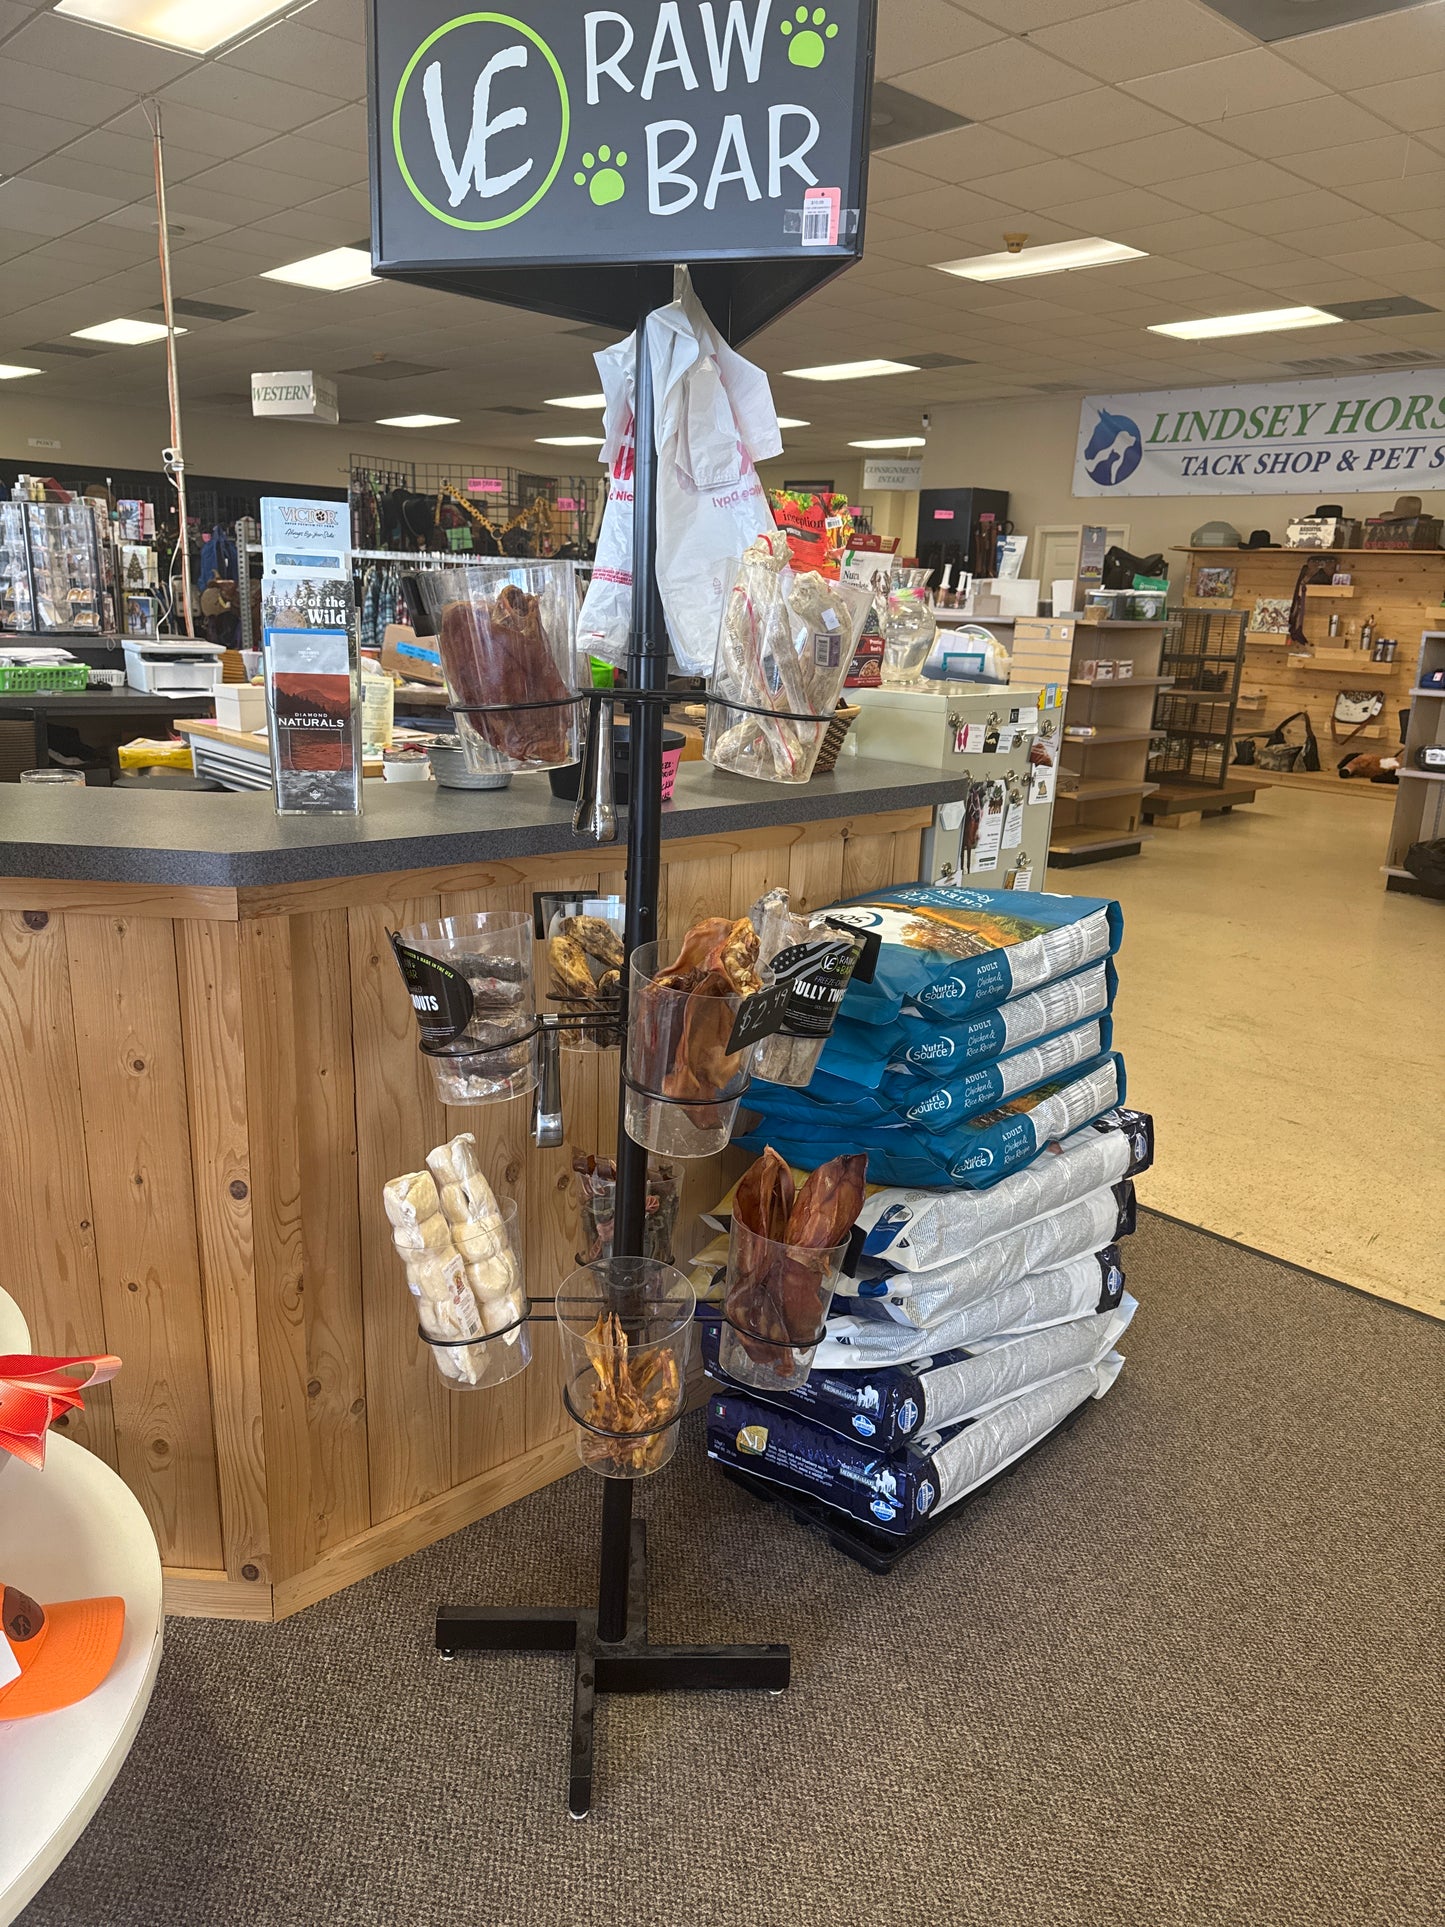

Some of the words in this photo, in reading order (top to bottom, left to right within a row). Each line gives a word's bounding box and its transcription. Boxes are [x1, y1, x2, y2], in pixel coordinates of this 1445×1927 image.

[584, 0, 772, 105] RAW
[645, 104, 820, 216] BAR
[252, 385, 312, 402] WESTERN
[1145, 402, 1327, 444] LINDSEY
[1181, 455, 1252, 477] TACK
[1253, 450, 1332, 475] SHOP
[1336, 449, 1361, 472] &
[1363, 446, 1427, 471] PET
[865, 466, 920, 474] CONSIGNMENT
[878, 475, 905, 483] INTAKE
[279, 506, 338, 526] VICTOR
[783, 510, 825, 529] inception
[271, 595, 304, 607] Taste
[308, 595, 321, 607] of
[325, 595, 346, 608] the
[308, 608, 347, 625] Wild
[278, 717, 345, 728] NATURALS
[976, 961, 999, 975] ADULT
[932, 981, 955, 994] Nutri
[924, 989, 958, 1002] Source
[968, 1019, 992, 1034] ADULT
[921, 1041, 944, 1053] Nutri
[967, 1032, 990, 1047] Chicken
[913, 1048, 948, 1060] Source
[966, 1047, 979, 1057] Rice
[965, 1070, 988, 1085] ADULT
[964, 1082, 987, 1098] Chicken
[964, 1098, 977, 1108] Rice
[1001, 1125, 1024, 1142] ADULT
